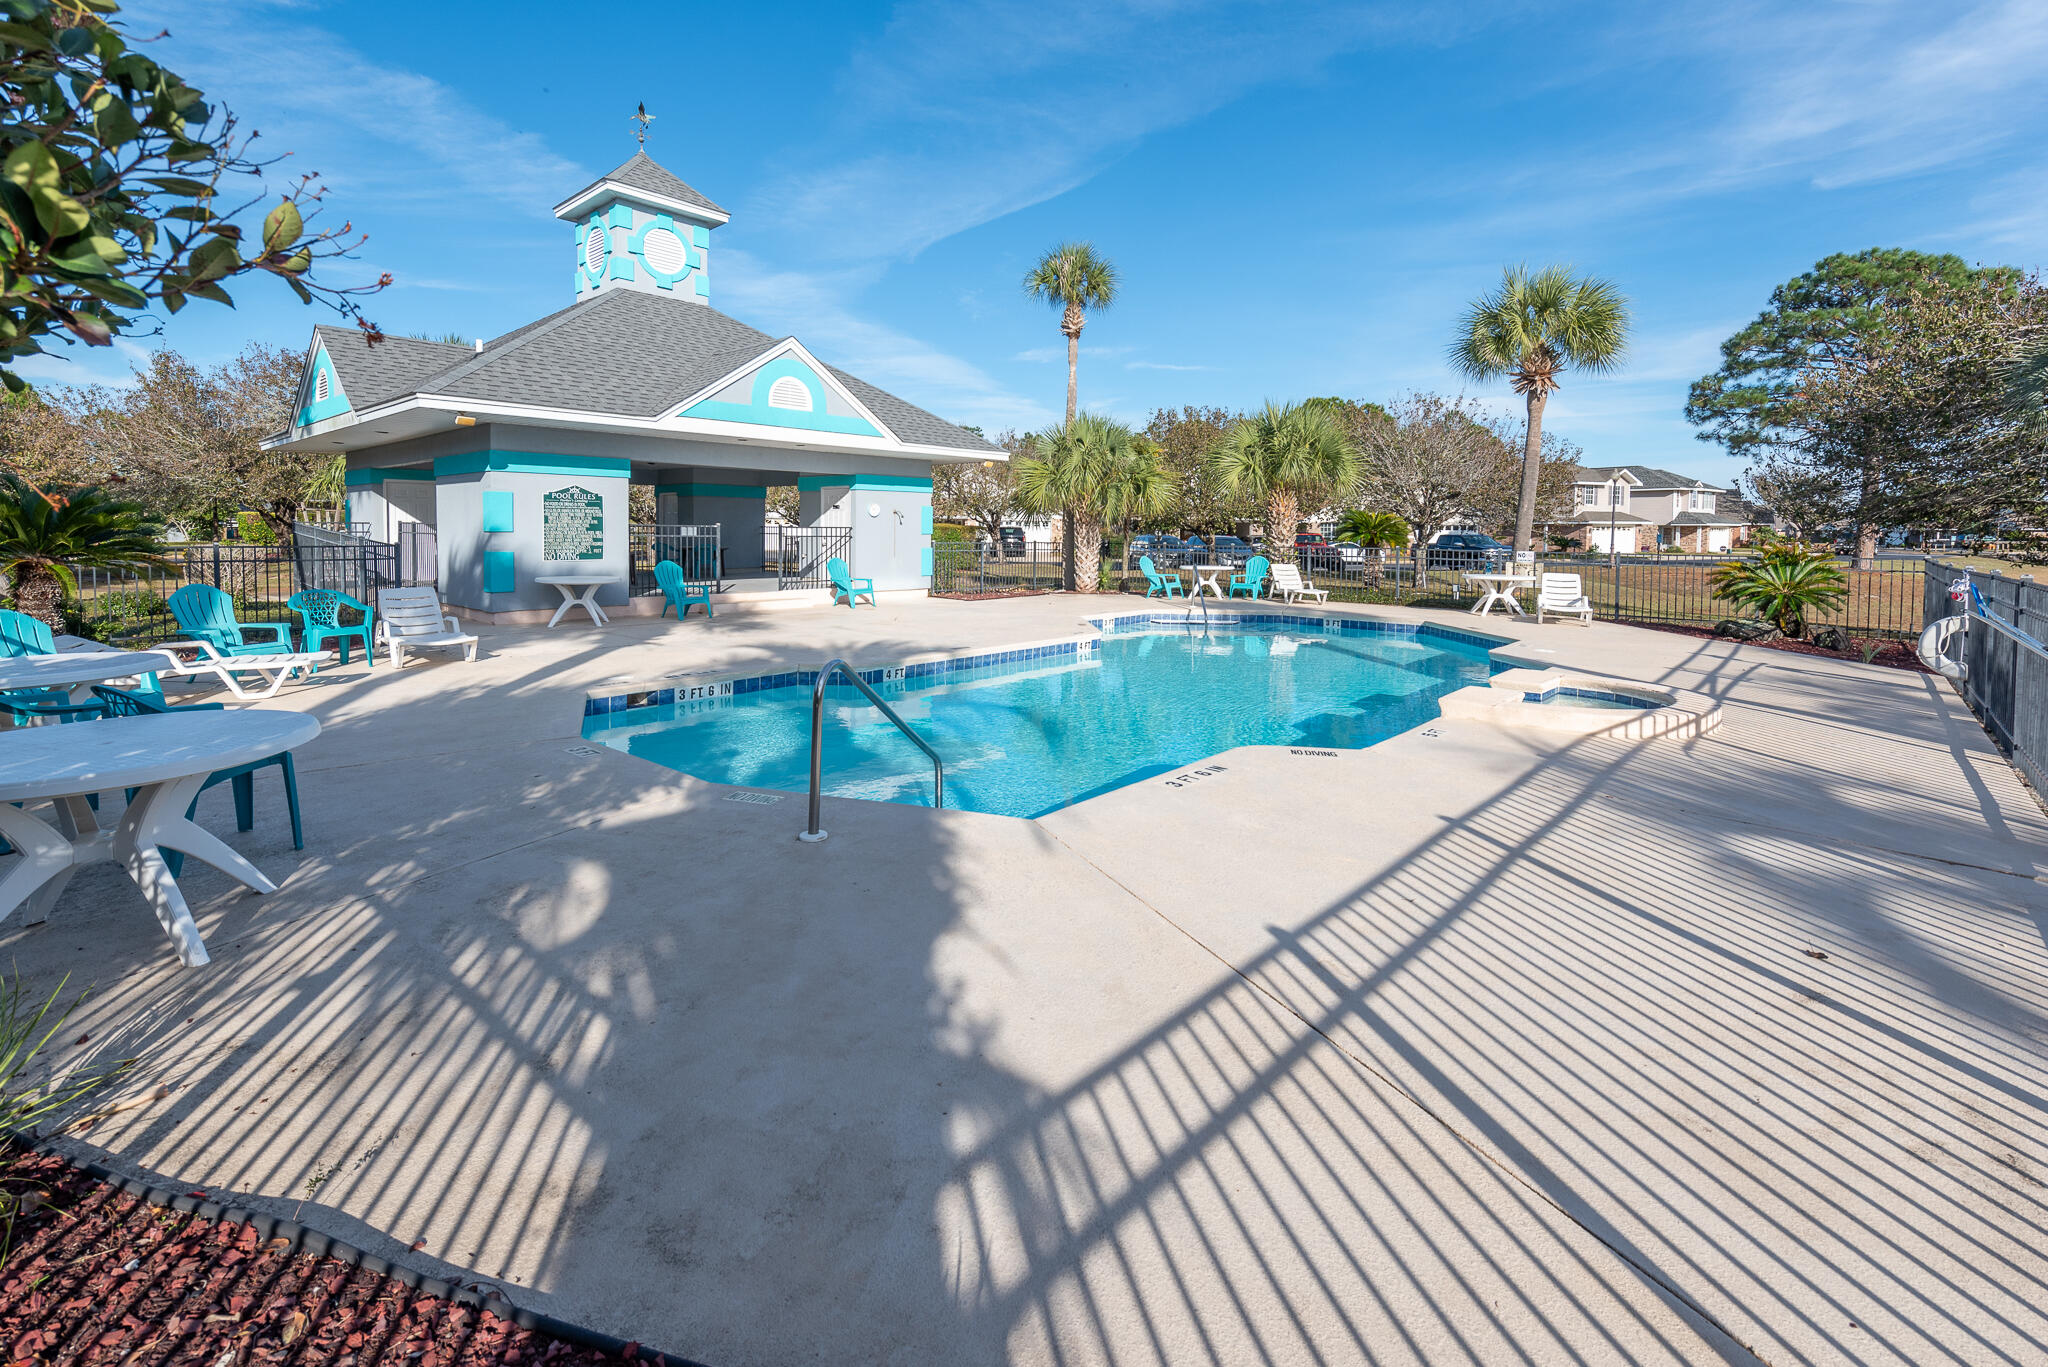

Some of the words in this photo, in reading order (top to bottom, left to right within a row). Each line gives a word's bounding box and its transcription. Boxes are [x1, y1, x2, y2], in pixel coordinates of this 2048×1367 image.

[545, 552, 556, 560] NO
[557, 552, 580, 560] DIVING
[885, 669, 892, 680] 4
[679, 689, 686, 700] 3
[708, 685, 715, 697] 6
[720, 682, 731, 695] IN
[1304, 750, 1338, 758] DIVING
[1175, 774, 1200, 783] FT
[1204, 765, 1229, 773] IN
